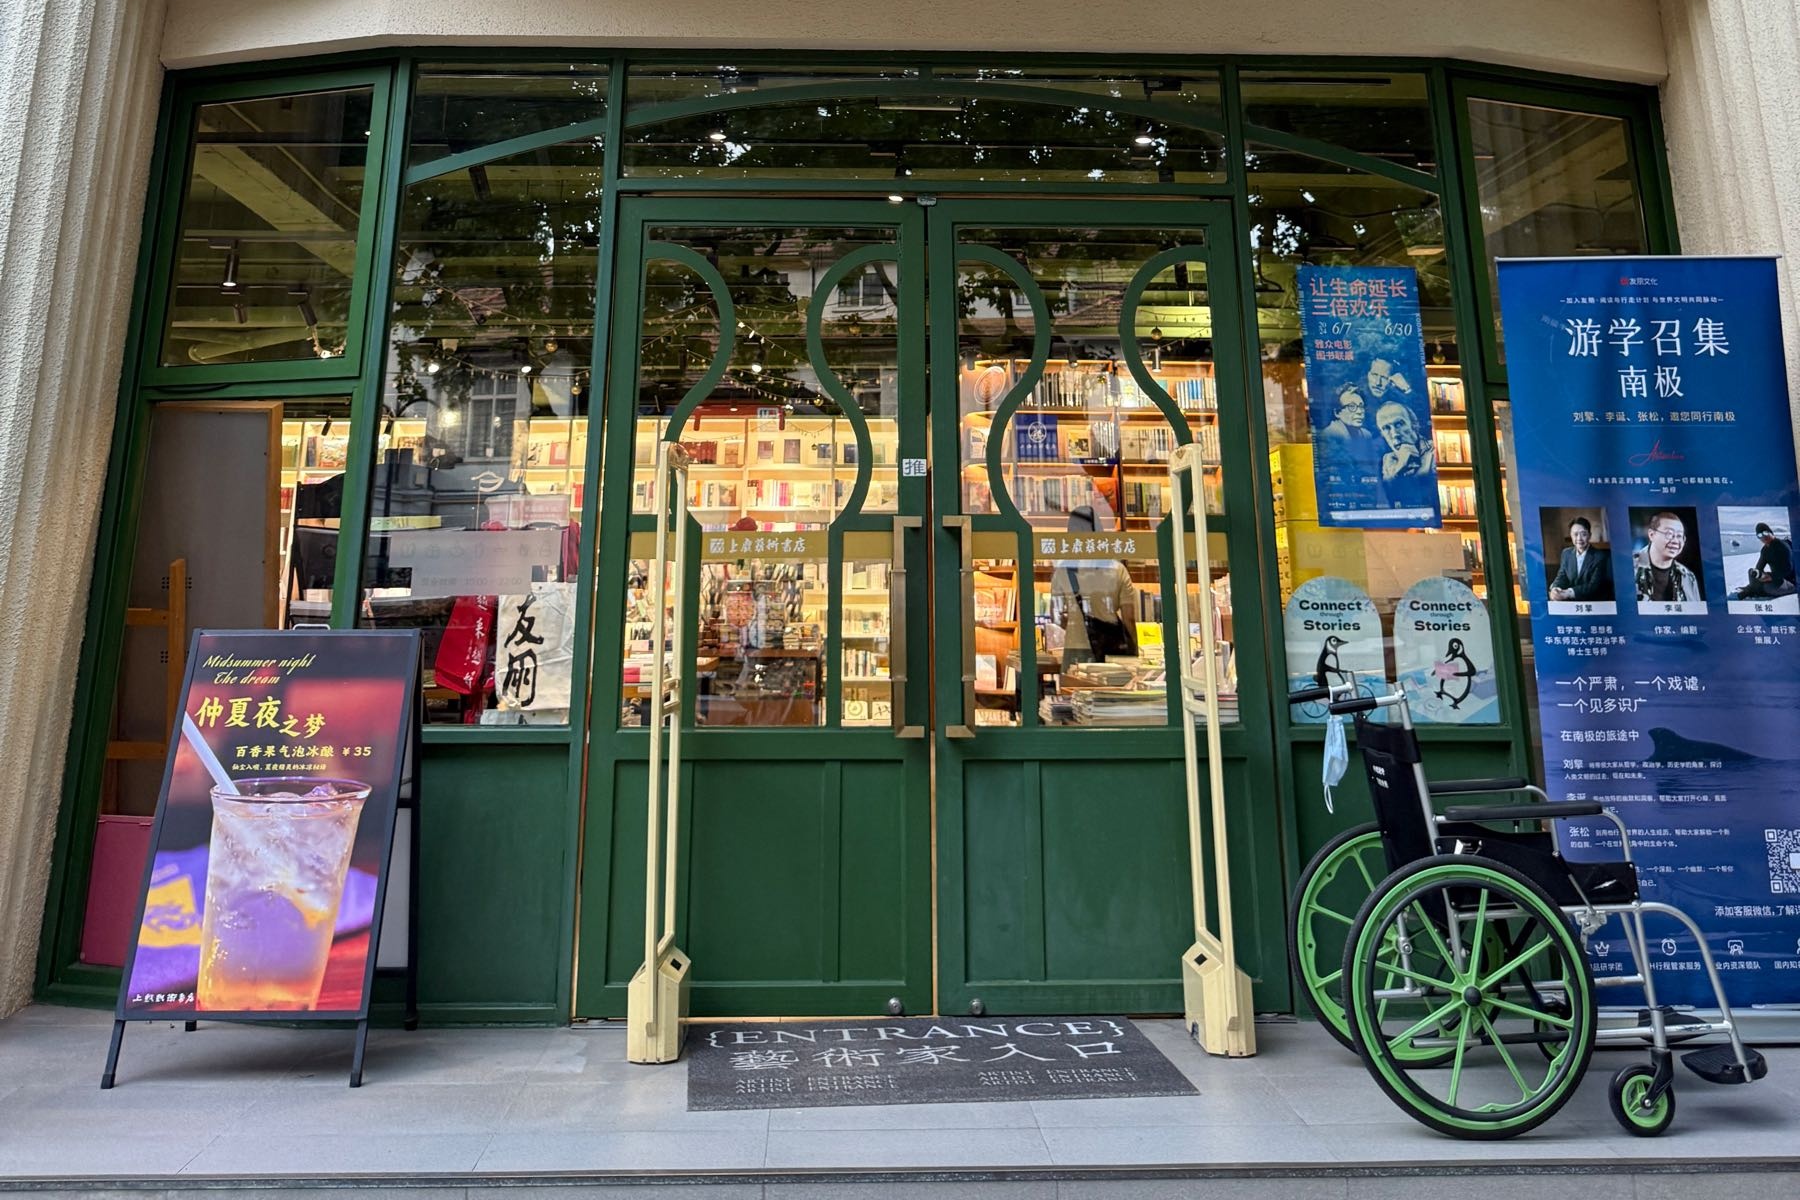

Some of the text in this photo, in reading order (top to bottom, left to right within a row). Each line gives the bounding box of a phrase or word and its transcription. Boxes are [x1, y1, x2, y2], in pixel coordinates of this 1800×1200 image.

[1309, 278, 1408, 298] 让生命延长
[1311, 298, 1390, 318] 三倍欢乐
[1331, 321, 1413, 337] 6/7 6/30
[1564, 316, 1731, 358] 游学召集
[1617, 365, 1685, 399] 南极
[903, 459, 926, 476] 推
[1299, 599, 1363, 612] Connect
[1409, 599, 1473, 612] Connect
[1754, 603, 1774, 613] 张松
[1303, 618, 1361, 632] Stories
[1414, 619, 1472, 632] Stories
[1544, 635, 1627, 646] 华东师范大学政治学系
[202, 652, 317, 676] Midsummer night
[213, 669, 281, 686] The dream
[1555, 675, 1707, 692] 一个严肃，一个戏谑，
[1557, 697, 1648, 714] 一个见多识广
[194, 695, 327, 739] 仲夏夜之梦
[1560, 729, 1640, 743] 在南极的旅途中
[235, 744, 335, 759] 百香果气泡冰酿
[1569, 826, 1590, 838] 张松
[1589, 962, 1623, 972] 品研学团
[1774, 960, 1800, 969] 国内知
[729, 1041, 1122, 1070] 藝術家入口
